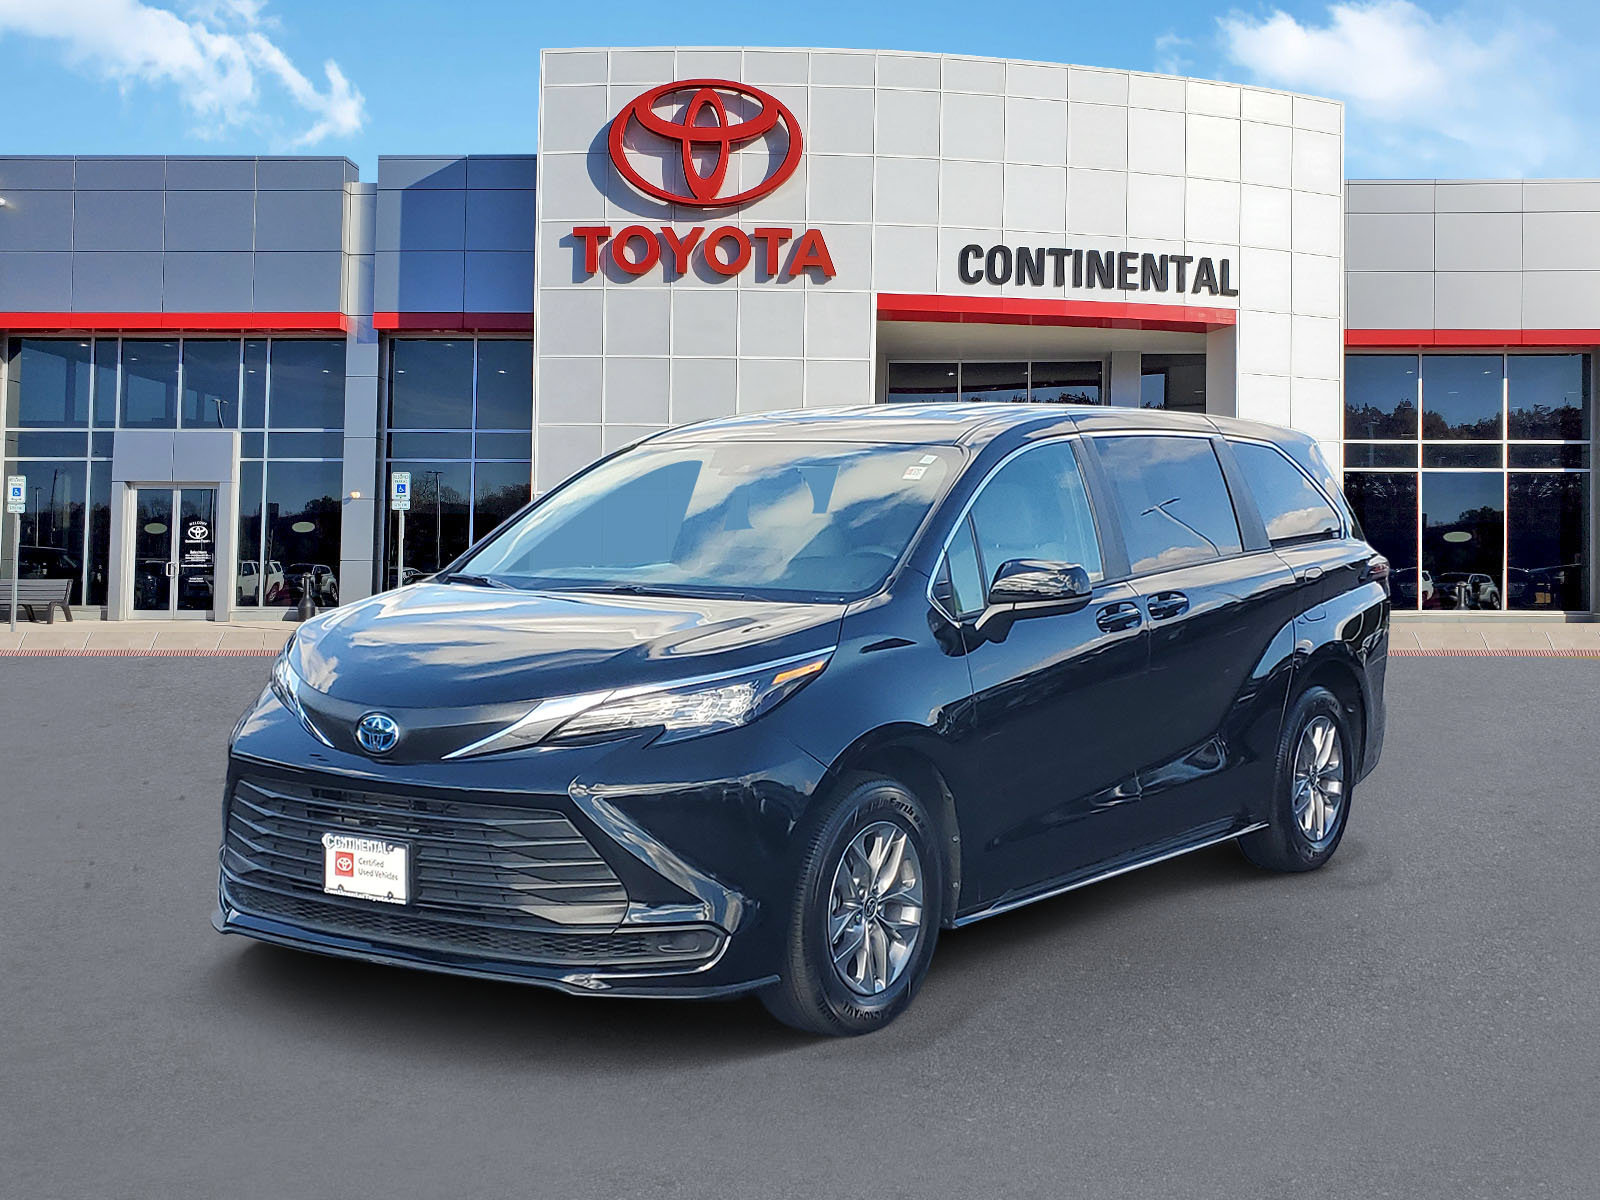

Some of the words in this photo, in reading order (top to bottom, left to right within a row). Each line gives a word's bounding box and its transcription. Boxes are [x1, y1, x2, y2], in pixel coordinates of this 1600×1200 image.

[572, 225, 836, 277] TOYOTA
[958, 244, 1239, 297] CONTINENTAL
[358, 857, 384, 868] Certified
[358, 868, 374, 877] Used
[374, 870, 399, 881] Vehicles
